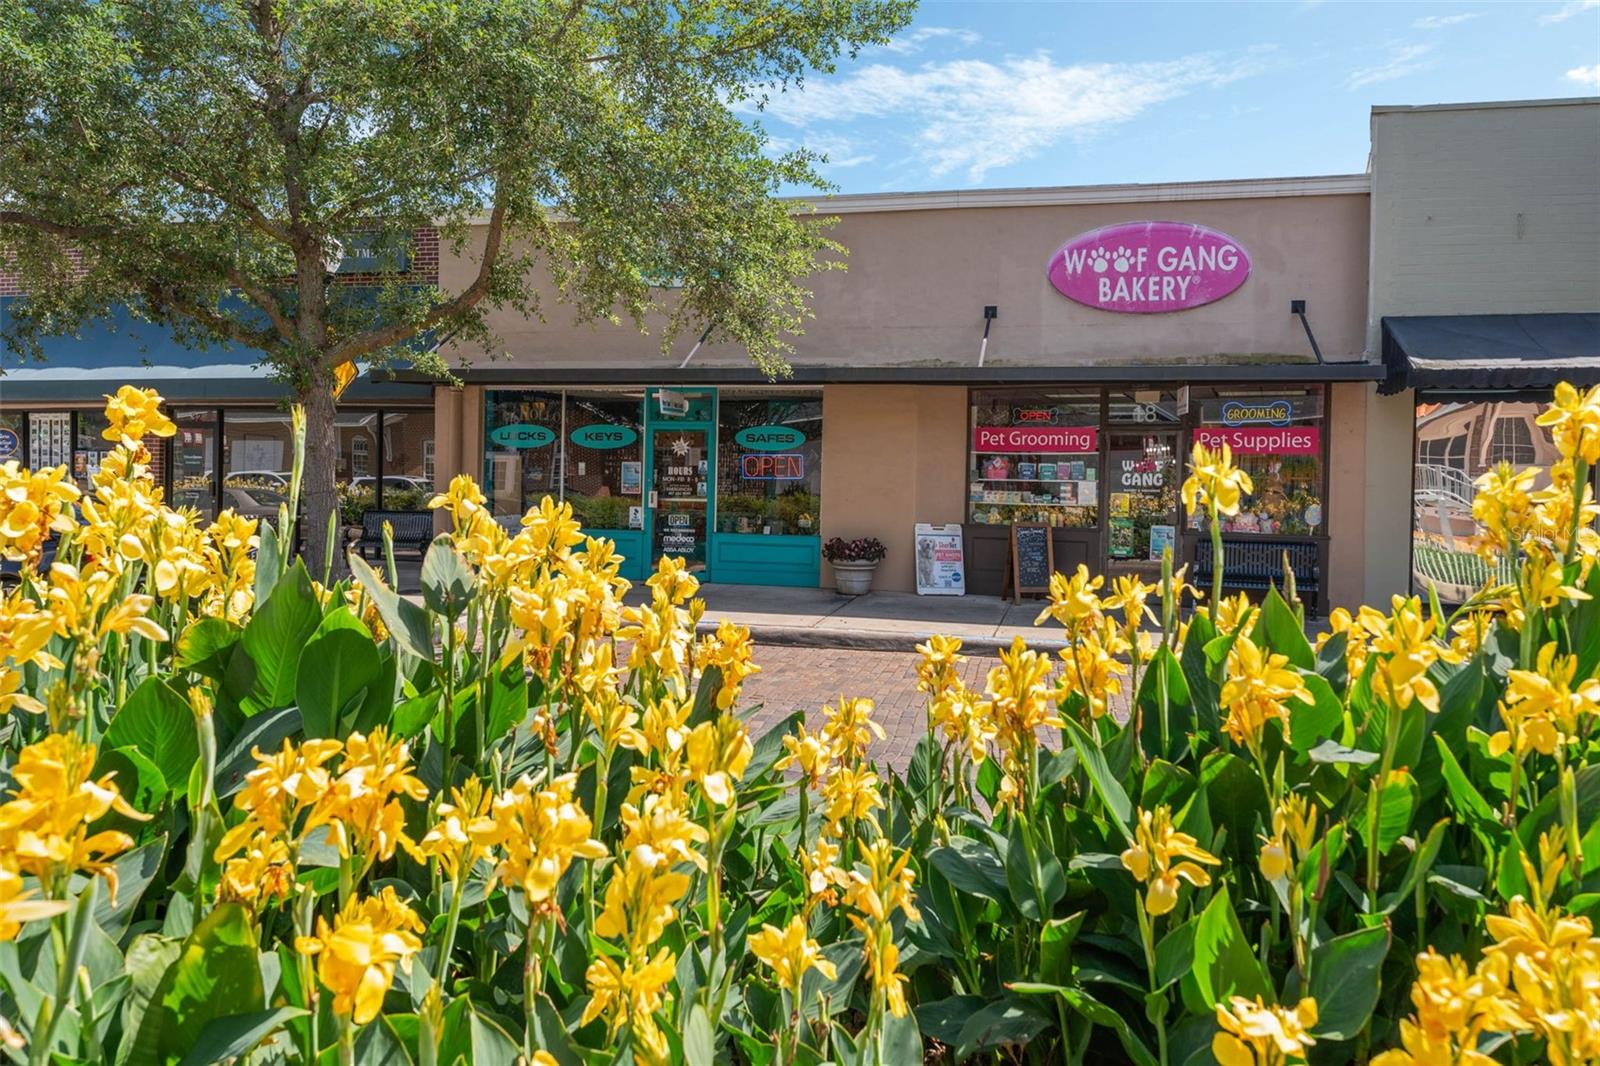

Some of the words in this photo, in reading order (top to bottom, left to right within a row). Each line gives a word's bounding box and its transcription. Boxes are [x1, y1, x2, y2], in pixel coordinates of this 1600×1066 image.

[1157, 245, 1238, 272] GANG
[1021, 412, 1052, 420] OPEN
[1227, 407, 1286, 420] GROOMING
[584, 431, 624, 441] KEYS
[745, 433, 795, 443] SAFES
[981, 431, 1005, 446] Pet
[1009, 431, 1090, 449] Grooming
[1200, 432, 1228, 448] Pet
[1233, 431, 1312, 452] Supplies
[667, 466, 693, 476] HOURS
[744, 456, 801, 477] OPEN
[1121, 472, 1163, 486] GANG
[670, 515, 690, 525] OPEN
